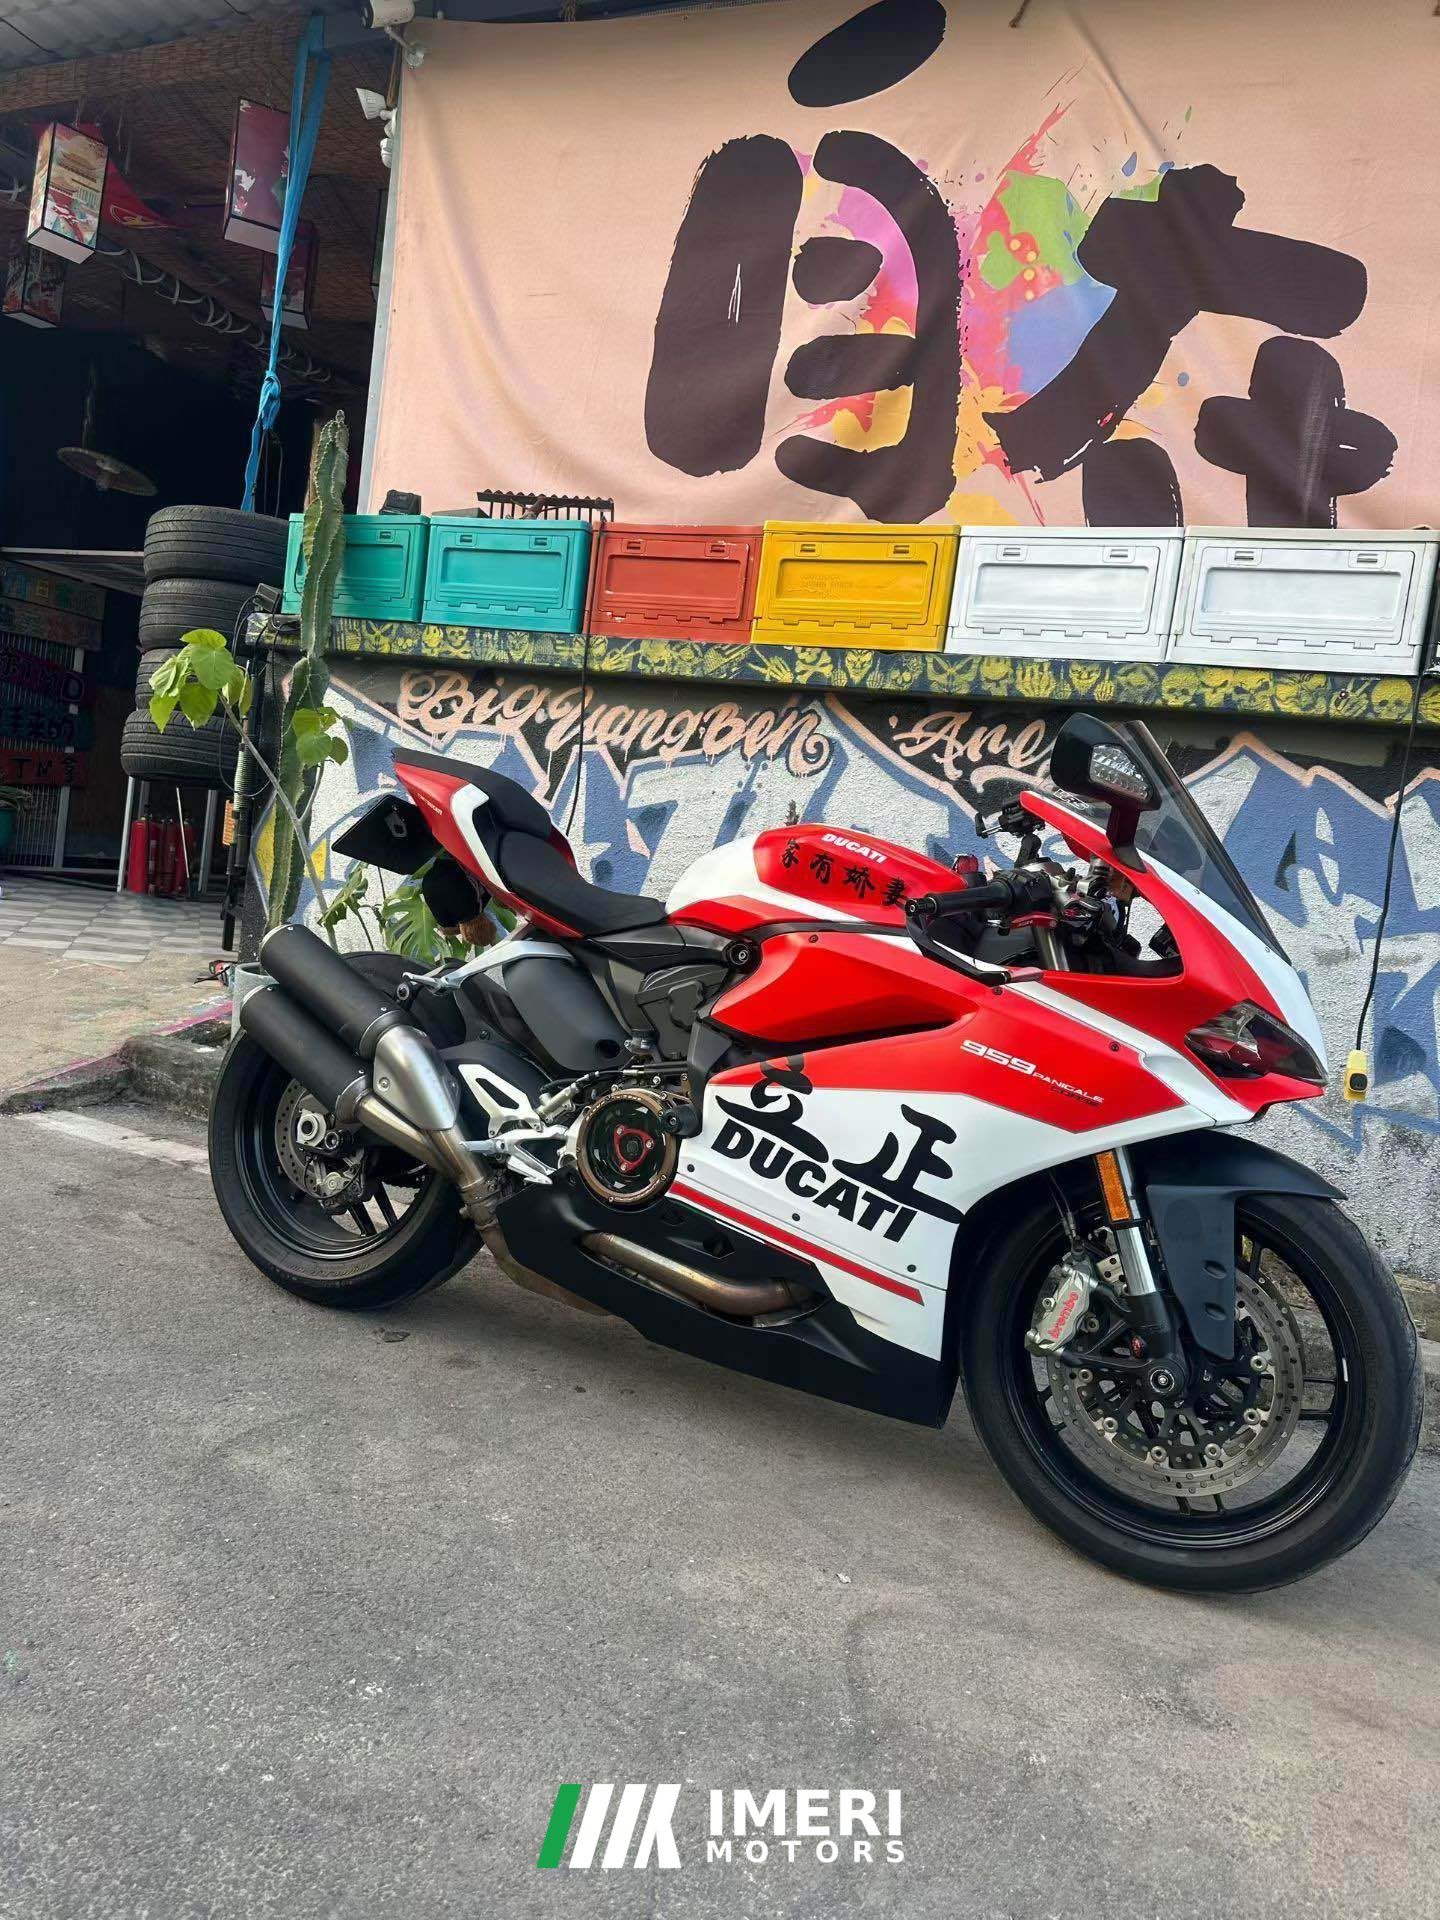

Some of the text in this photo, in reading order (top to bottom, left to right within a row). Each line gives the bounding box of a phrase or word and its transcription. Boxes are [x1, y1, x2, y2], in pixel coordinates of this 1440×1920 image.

[646, 0, 1397, 526] 自在
[821, 833, 888, 864] DUCATI
[960, 1039, 1037, 1075] 959
[1032, 1071, 1105, 1103] PANIGALE
[711, 1118, 918, 1243] DUCATI
